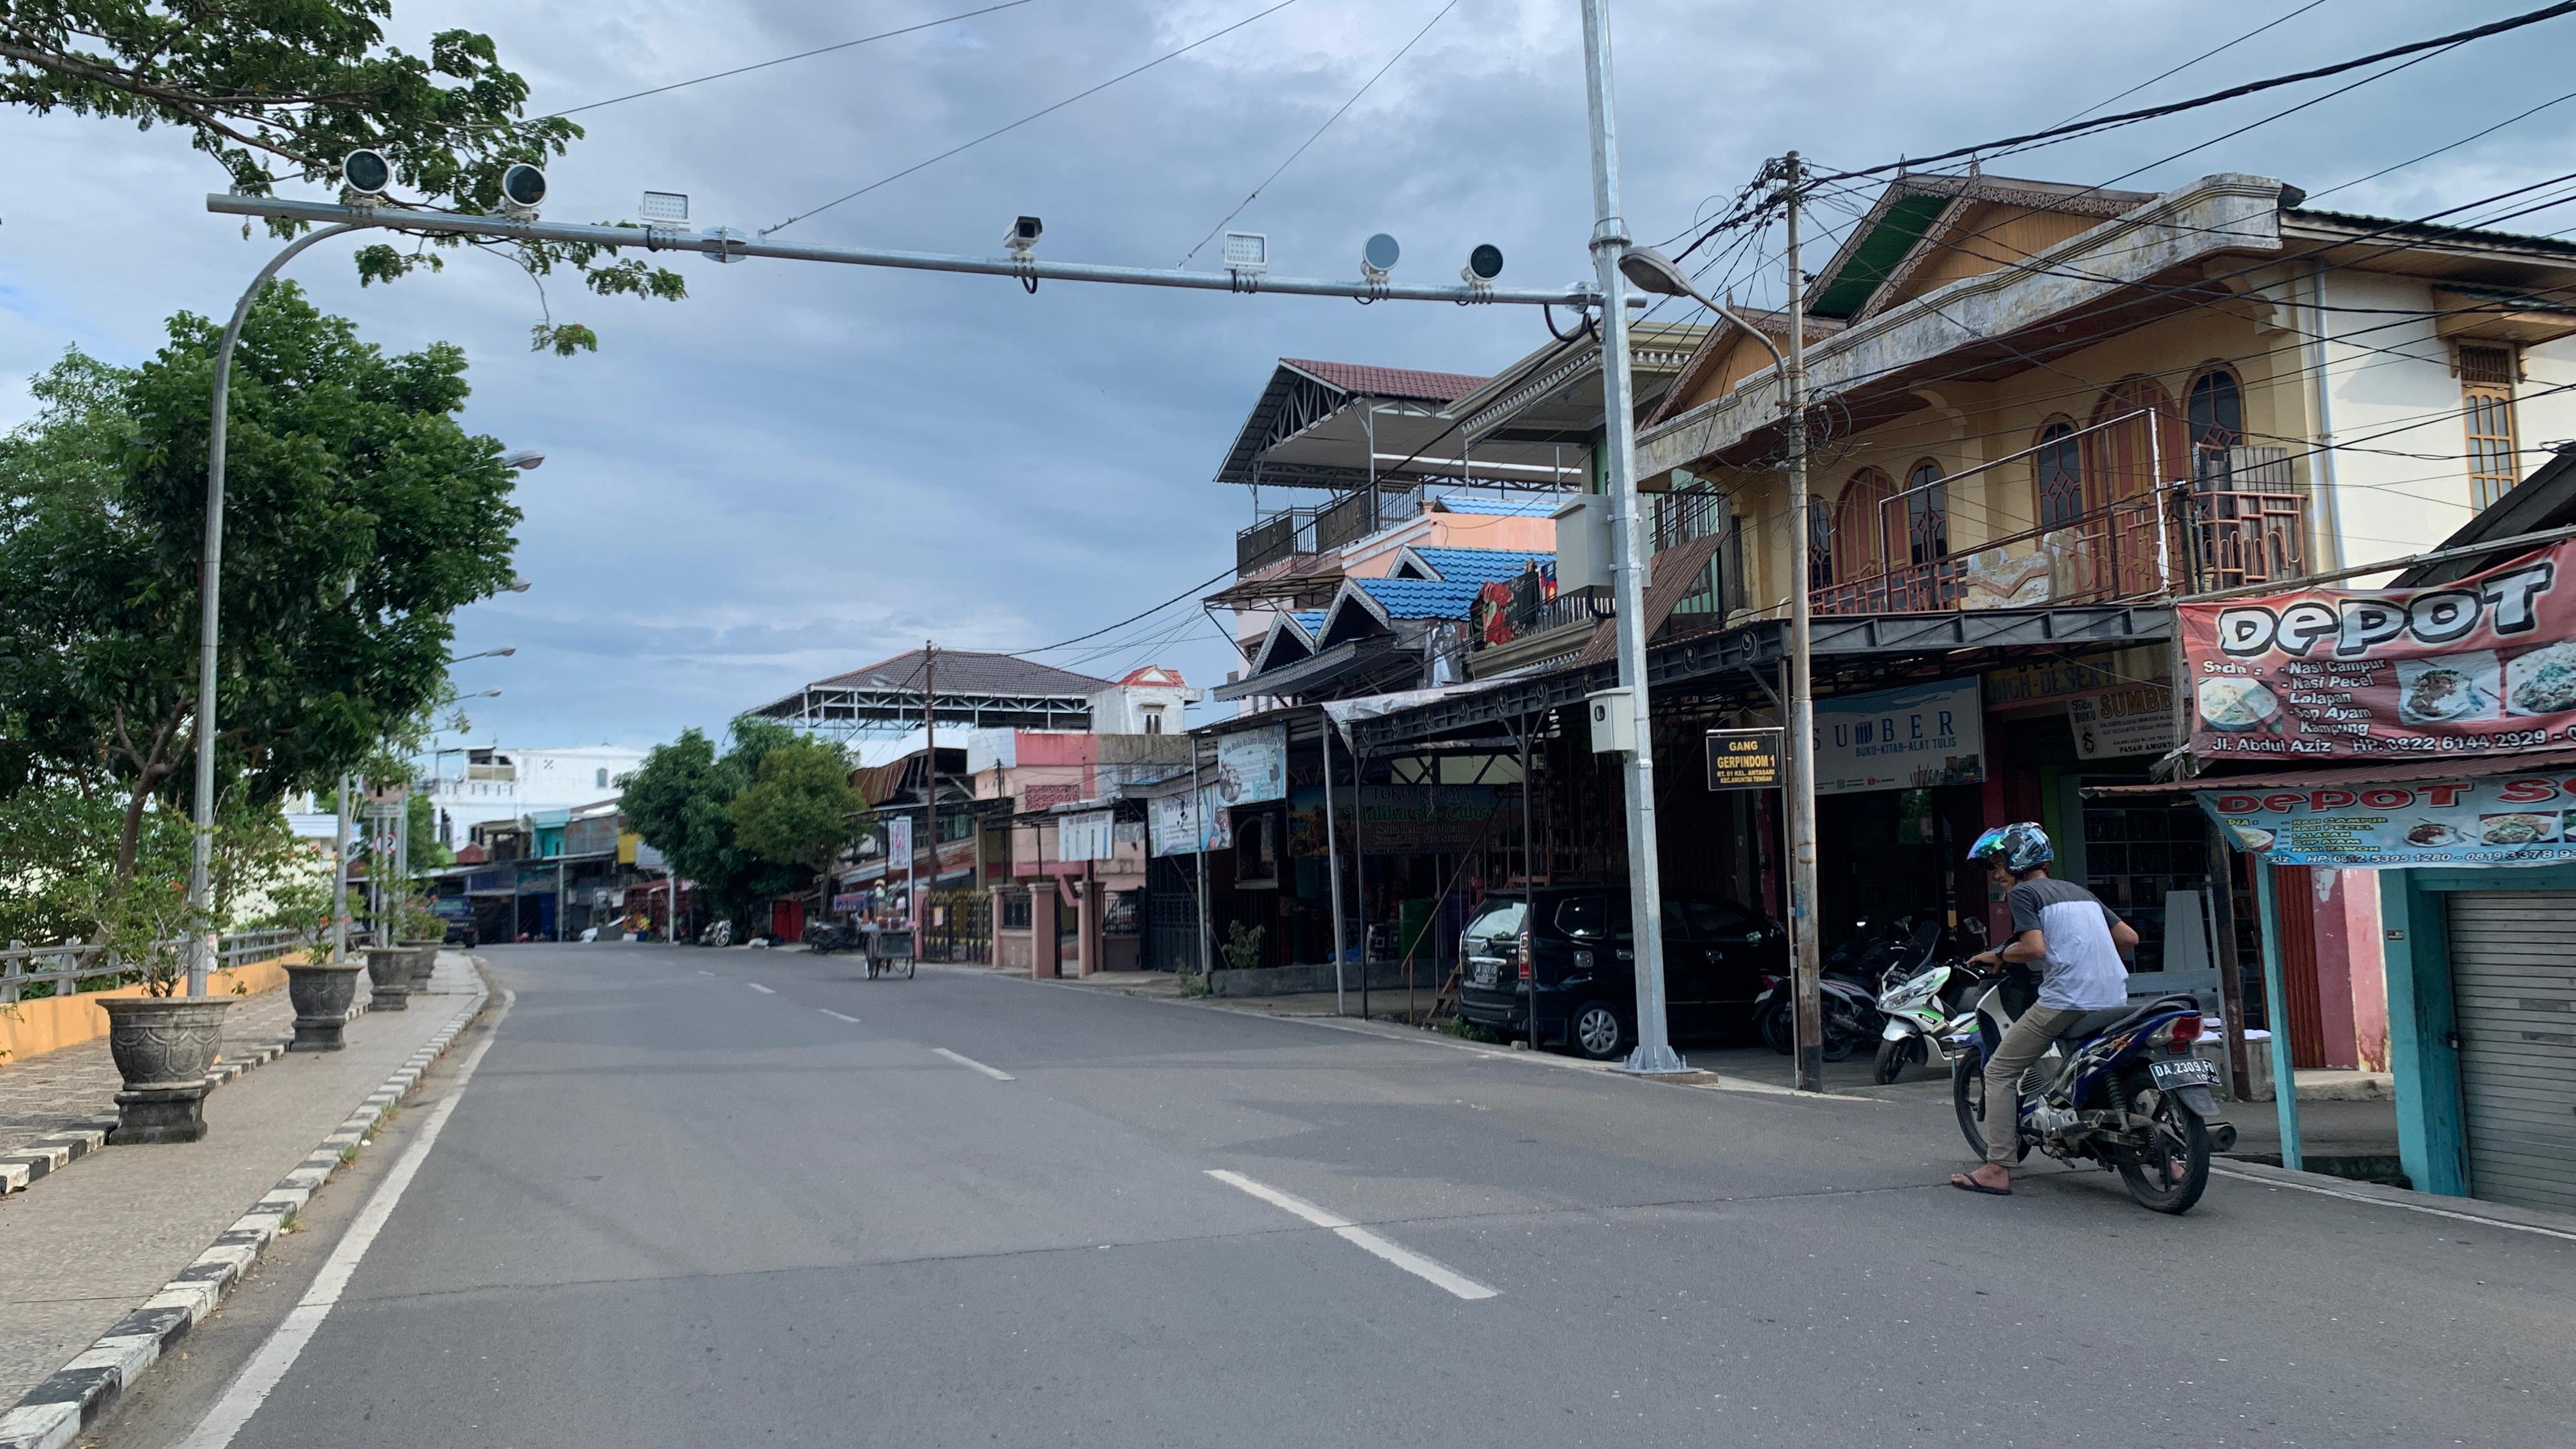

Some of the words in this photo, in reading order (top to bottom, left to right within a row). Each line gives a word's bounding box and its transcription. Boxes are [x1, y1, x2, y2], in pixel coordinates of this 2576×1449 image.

[2289, 661, 2322, 674] Nasi
[2326, 659, 2386, 675] Campur
[2292, 676, 2324, 690] Nasi
[2329, 674, 2375, 689] Pecel
[2289, 692, 2352, 707] Lalapan
[2074, 710, 2096, 724] BUKU
[2324, 707, 2373, 722] Ayam
[2301, 723, 2370, 737] Kampung
[1729, 740, 1758, 751] GANG
[1932, 736, 1956, 748] TULIS
[2237, 739, 2286, 752] Abdul
[2290, 739, 2332, 752] Aziz
[2386, 737, 2435, 752] 0822
[2442, 736, 2490, 749] 6144
[2494, 730, 2547, 747] 2929
[1717, 755, 1768, 769] GERPINDOM
[1770, 755, 1775, 767] 1
[2496, 777, 2576, 803] S
[2333, 854, 2366, 863] 0812
[2371, 854, 2409, 862] 5395
[2414, 853, 2451, 862] 1280
[2465, 852, 2502, 861] 0819
[2506, 850, 2554, 860] 3378
[2154, 1064, 2172, 1077] DA
